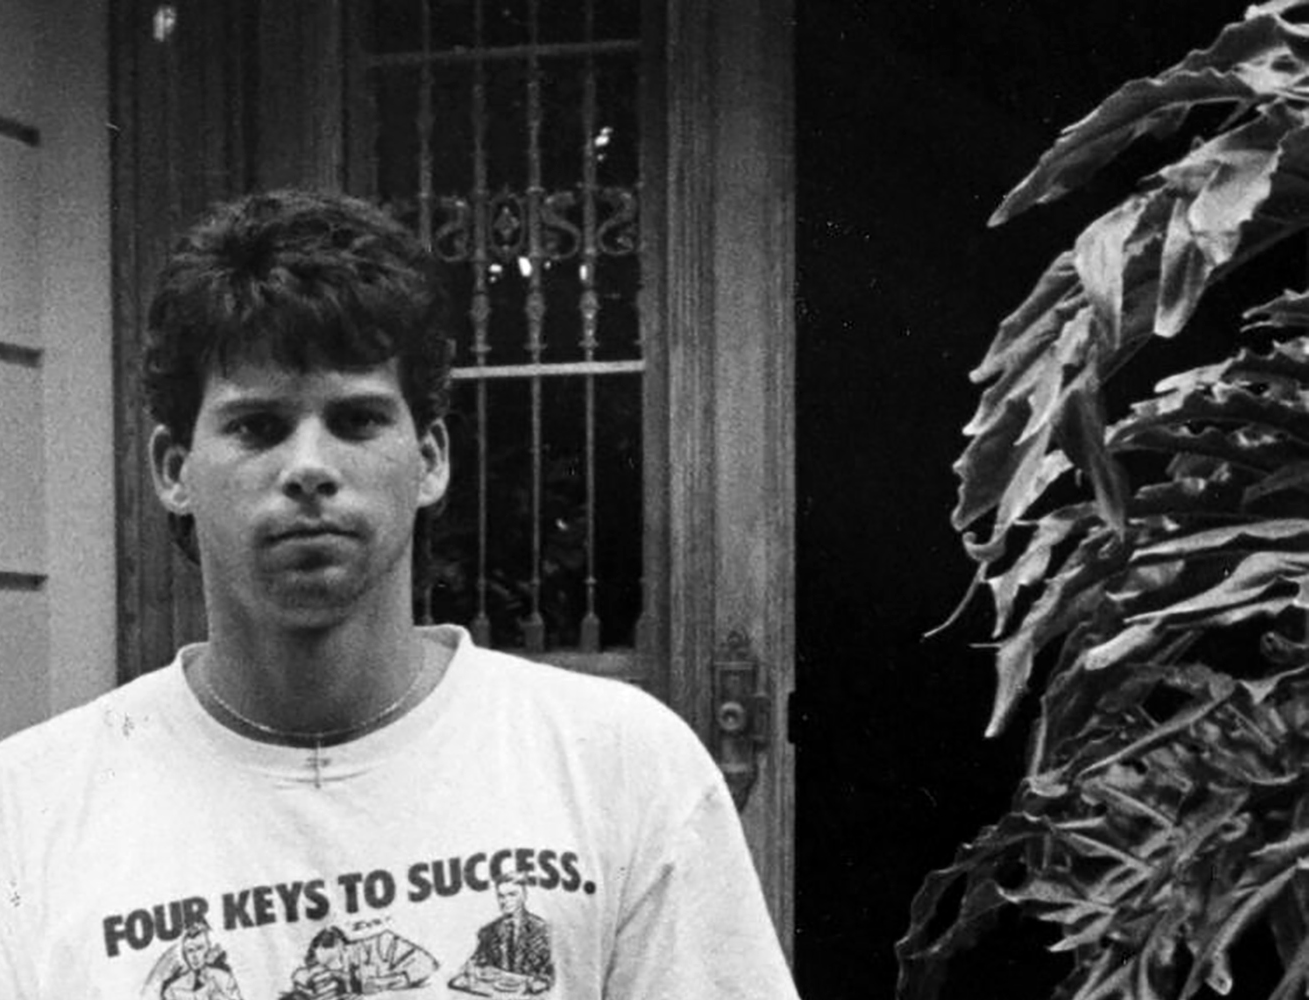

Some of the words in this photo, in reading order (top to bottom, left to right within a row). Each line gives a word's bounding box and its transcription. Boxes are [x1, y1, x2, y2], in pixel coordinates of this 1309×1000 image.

[102, 896, 212, 958] FOUR
[221, 878, 330, 930] KEYS
[337, 869, 396, 914] TO
[408, 848, 597, 903] SUCCESS.
